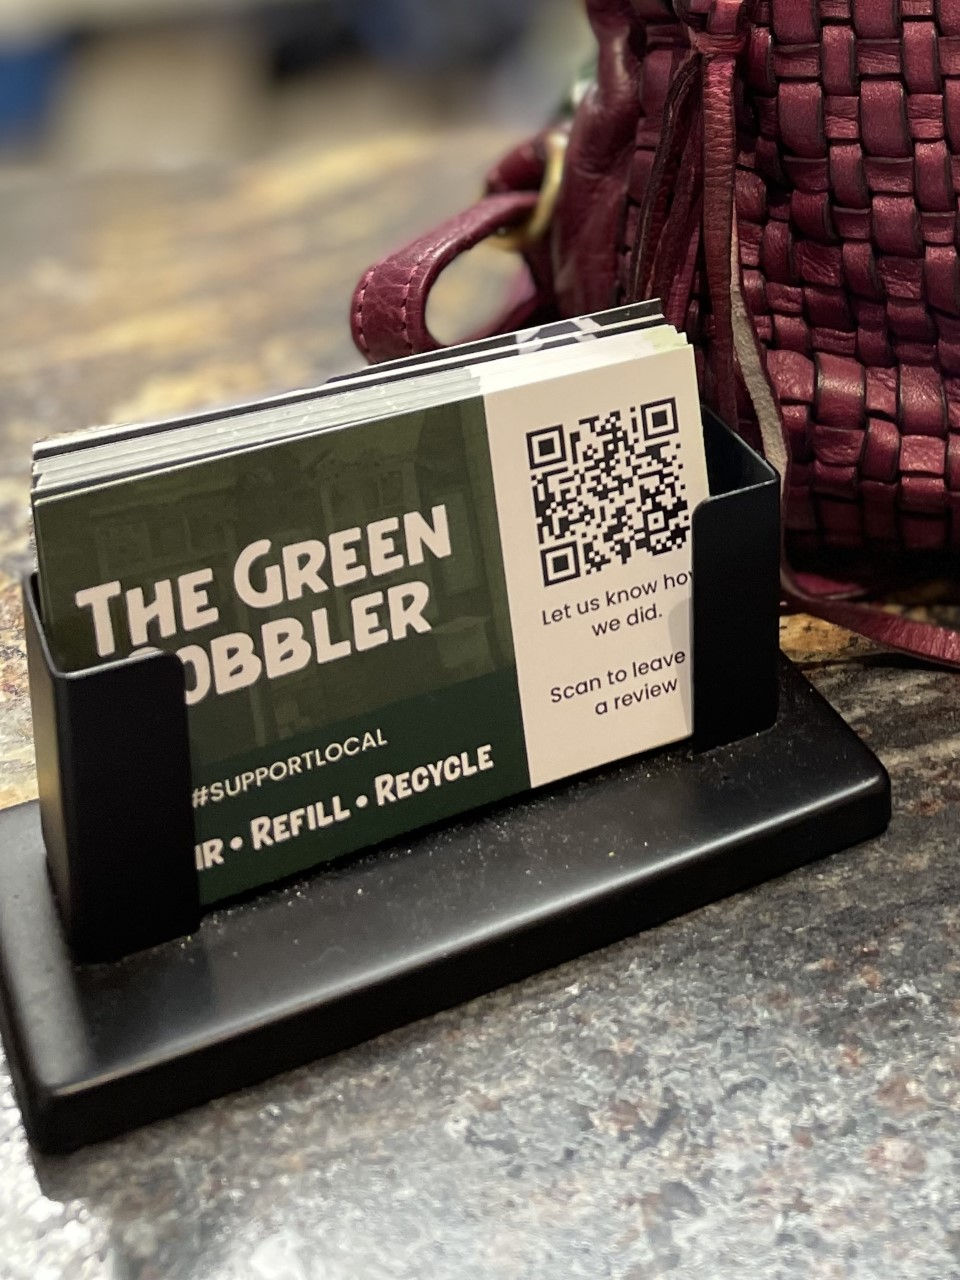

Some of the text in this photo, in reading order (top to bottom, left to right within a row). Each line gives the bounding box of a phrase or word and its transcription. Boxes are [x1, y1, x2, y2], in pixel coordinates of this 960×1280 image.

[75, 504, 452, 658] THE GREEN
[542, 604, 571, 625] Let
[577, 598, 600, 615] us
[606, 580, 658, 606] know
[128, 581, 432, 706] OBBLER
[592, 603, 662, 636] we did.
[550, 650, 686, 703] Scan to leave
[595, 678, 678, 715] a review
[192, 728, 388, 808] #SUPPORTLOCAL
[251, 795, 351, 850] REFILL
[374, 744, 494, 807] RECYCLE
